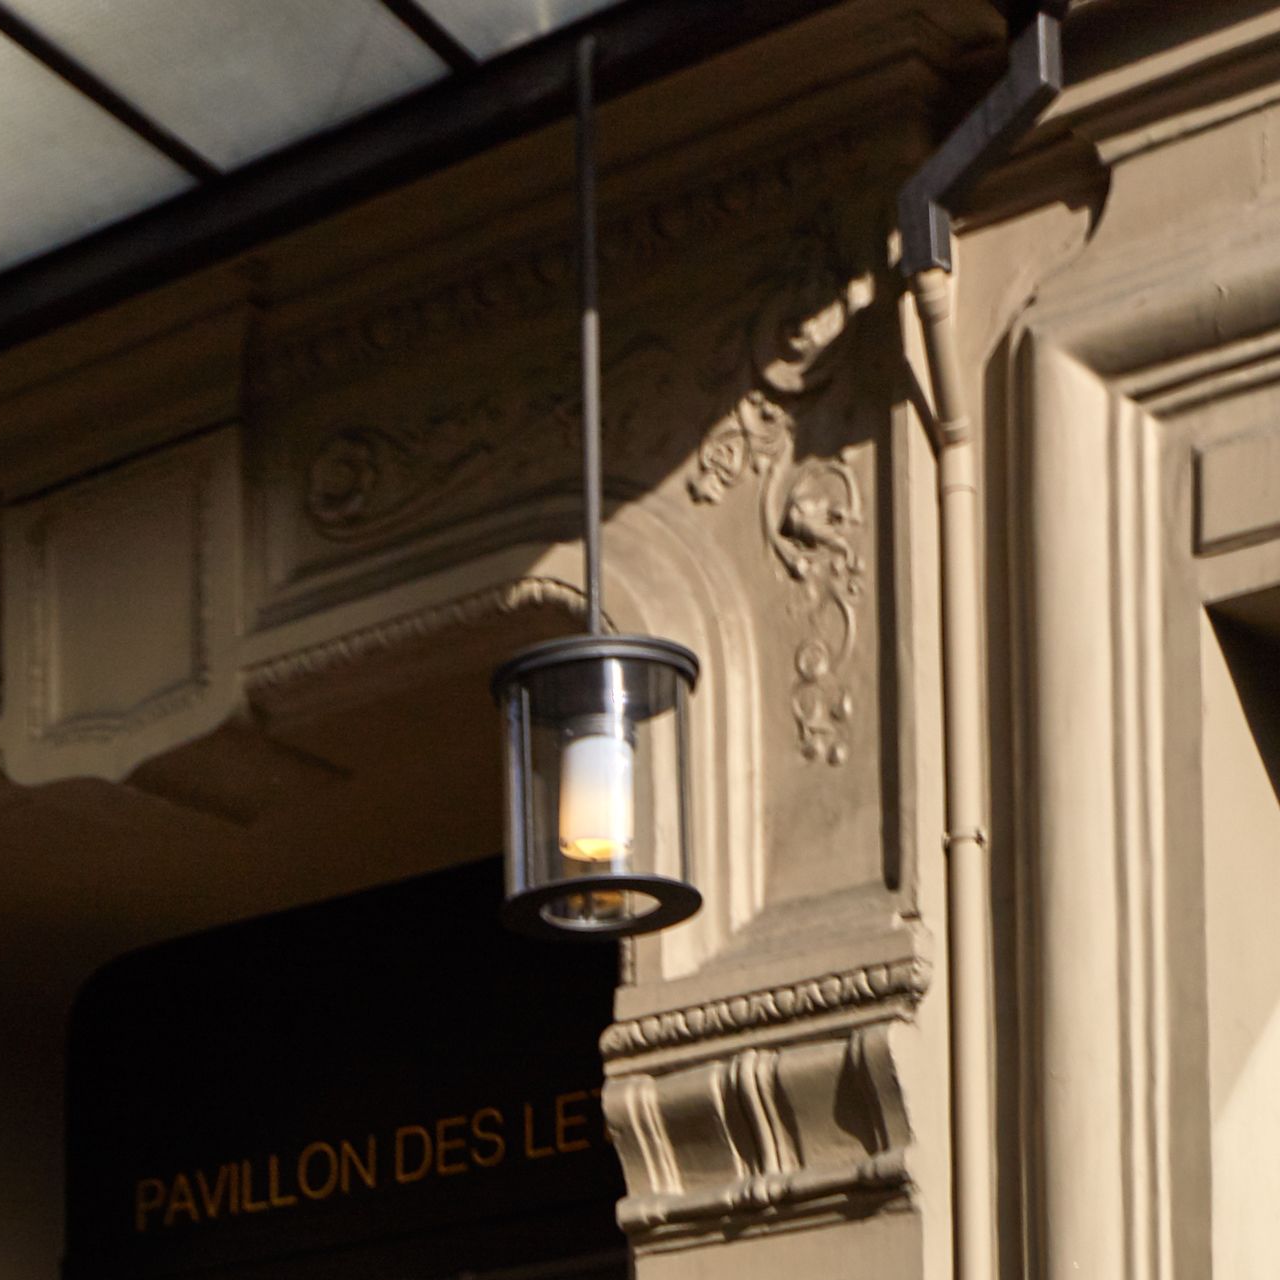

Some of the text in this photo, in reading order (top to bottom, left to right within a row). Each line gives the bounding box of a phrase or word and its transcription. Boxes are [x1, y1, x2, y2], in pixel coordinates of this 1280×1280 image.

[134, 1087, 612, 1232] PAVILLON DES LE
